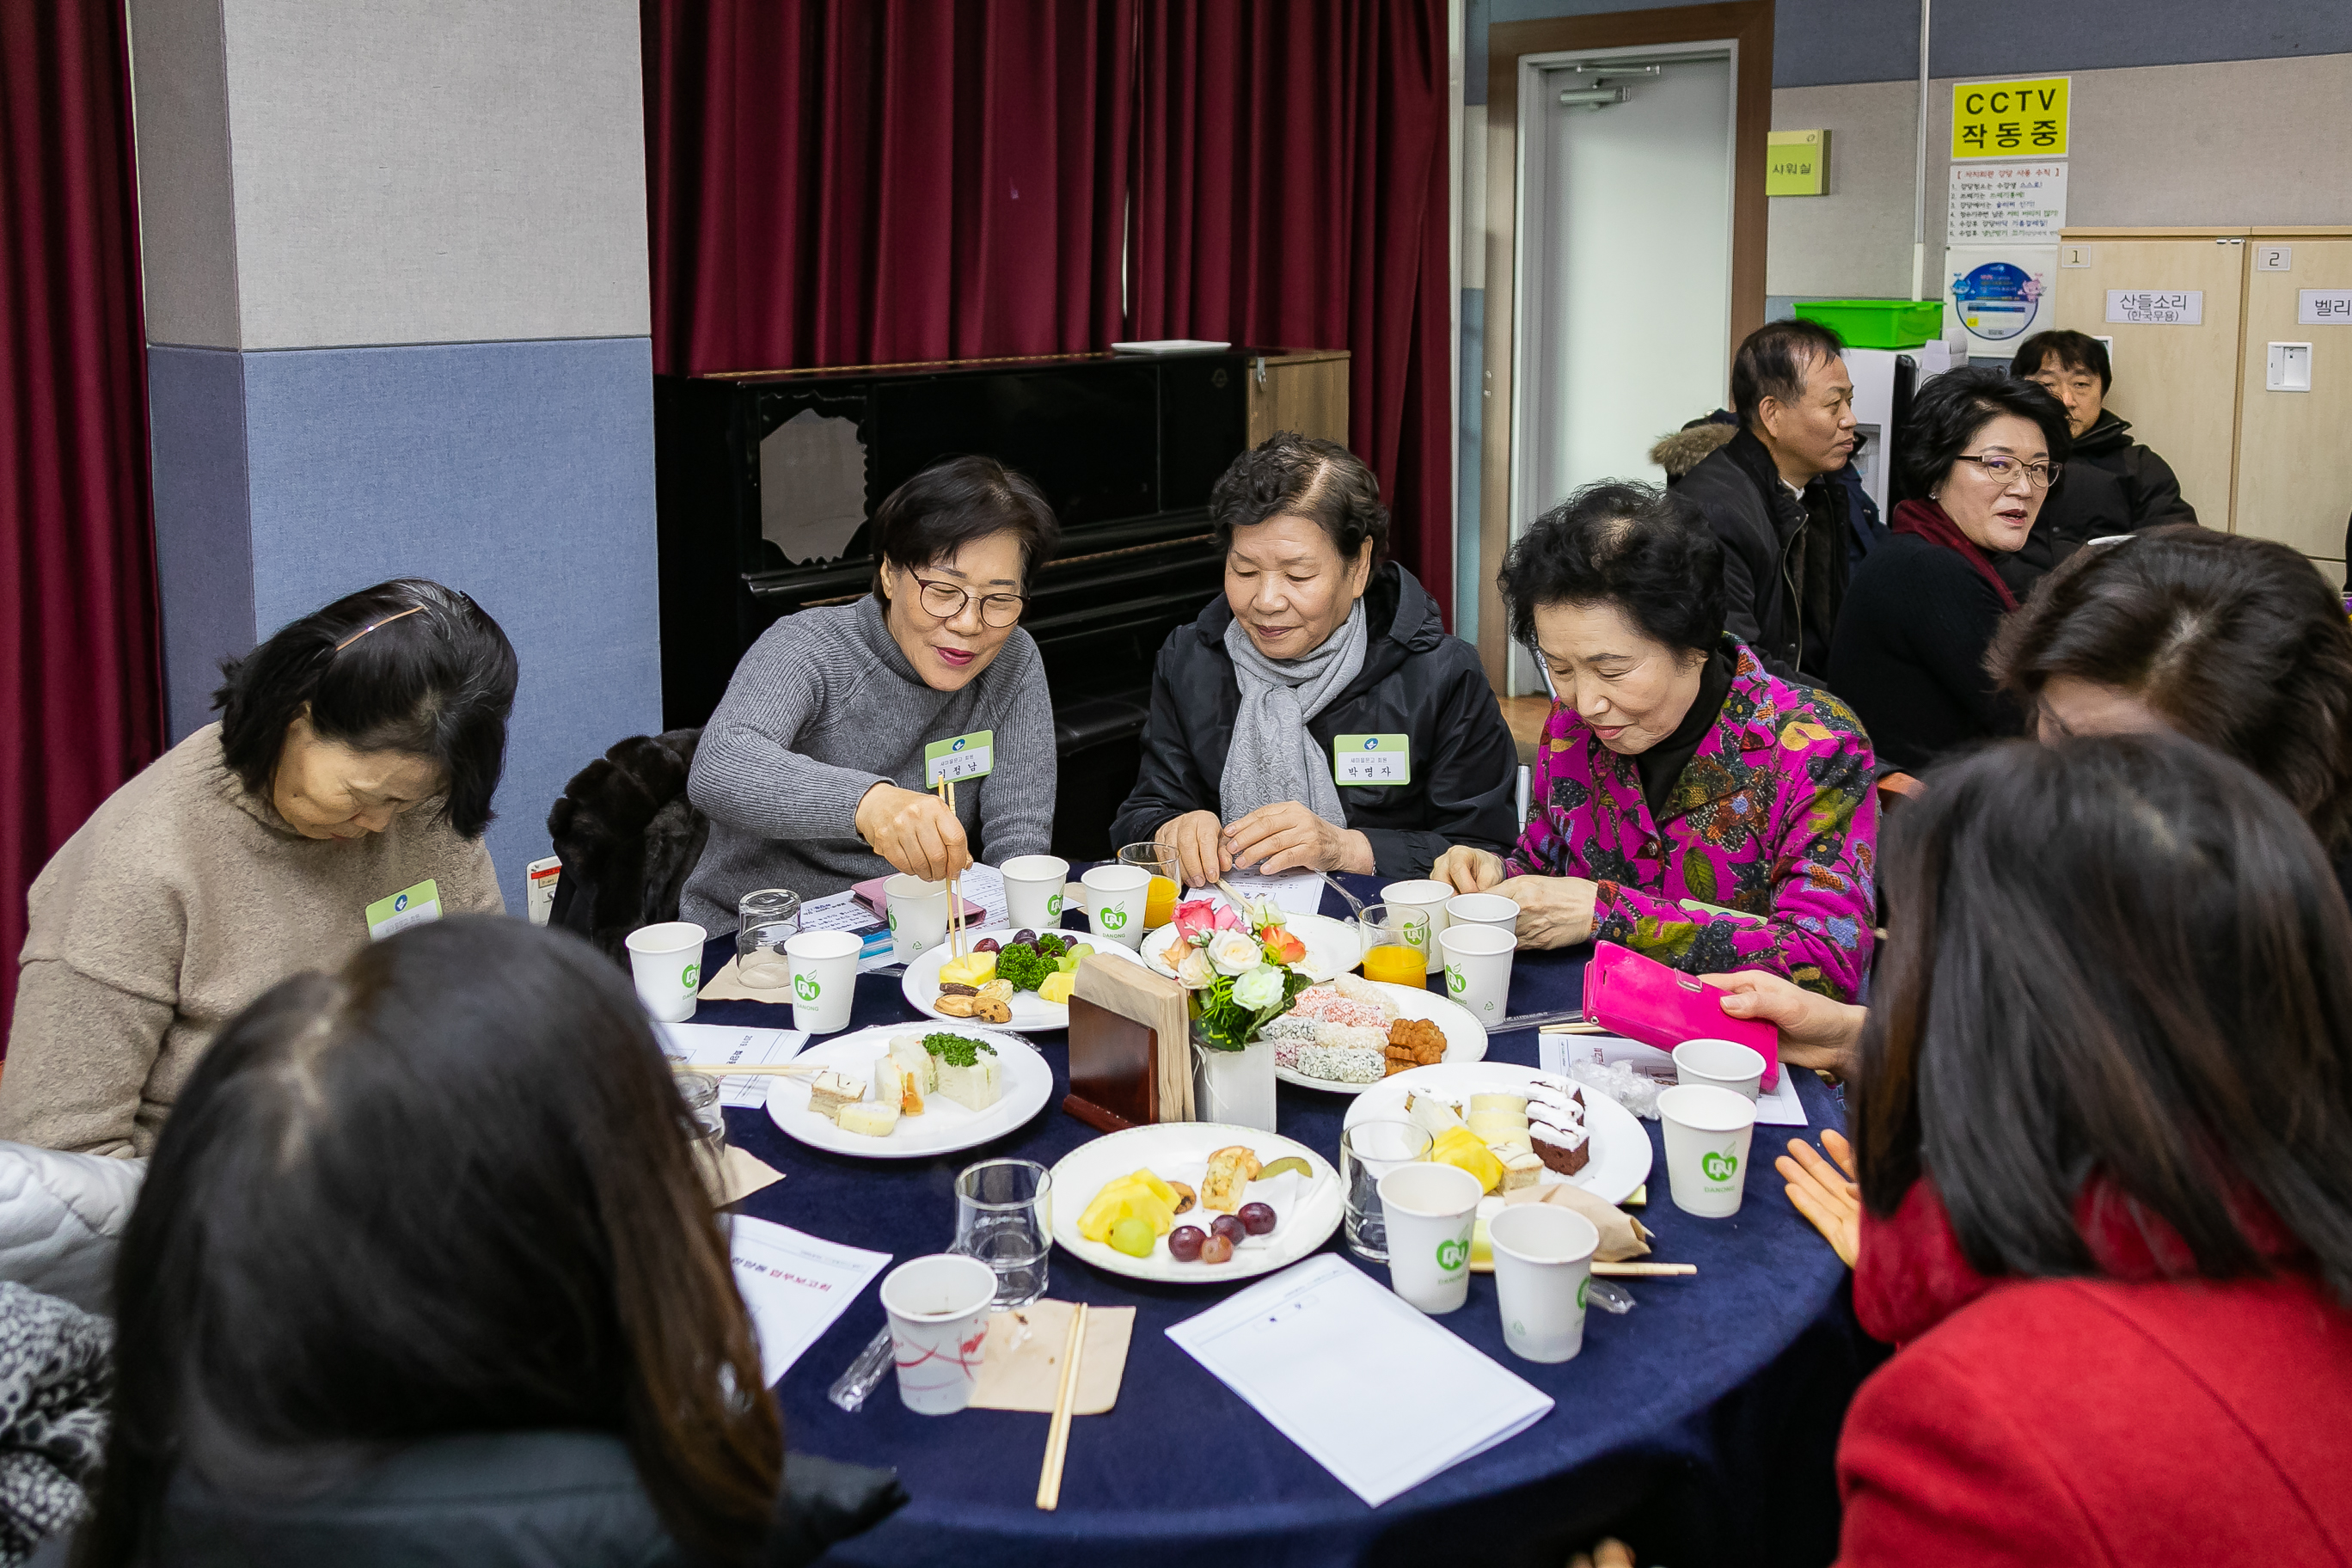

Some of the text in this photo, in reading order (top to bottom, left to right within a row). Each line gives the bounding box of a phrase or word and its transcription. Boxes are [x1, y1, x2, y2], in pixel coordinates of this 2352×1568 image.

[1965, 88, 2056, 115] CCTV
[1962, 119, 2058, 149] 작동중
[2071, 249, 2080, 264] 1
[2269, 251, 2281, 266] 2
[2120, 293, 2188, 311] 산들소리
[796, 1003, 819, 1013] DANONG
